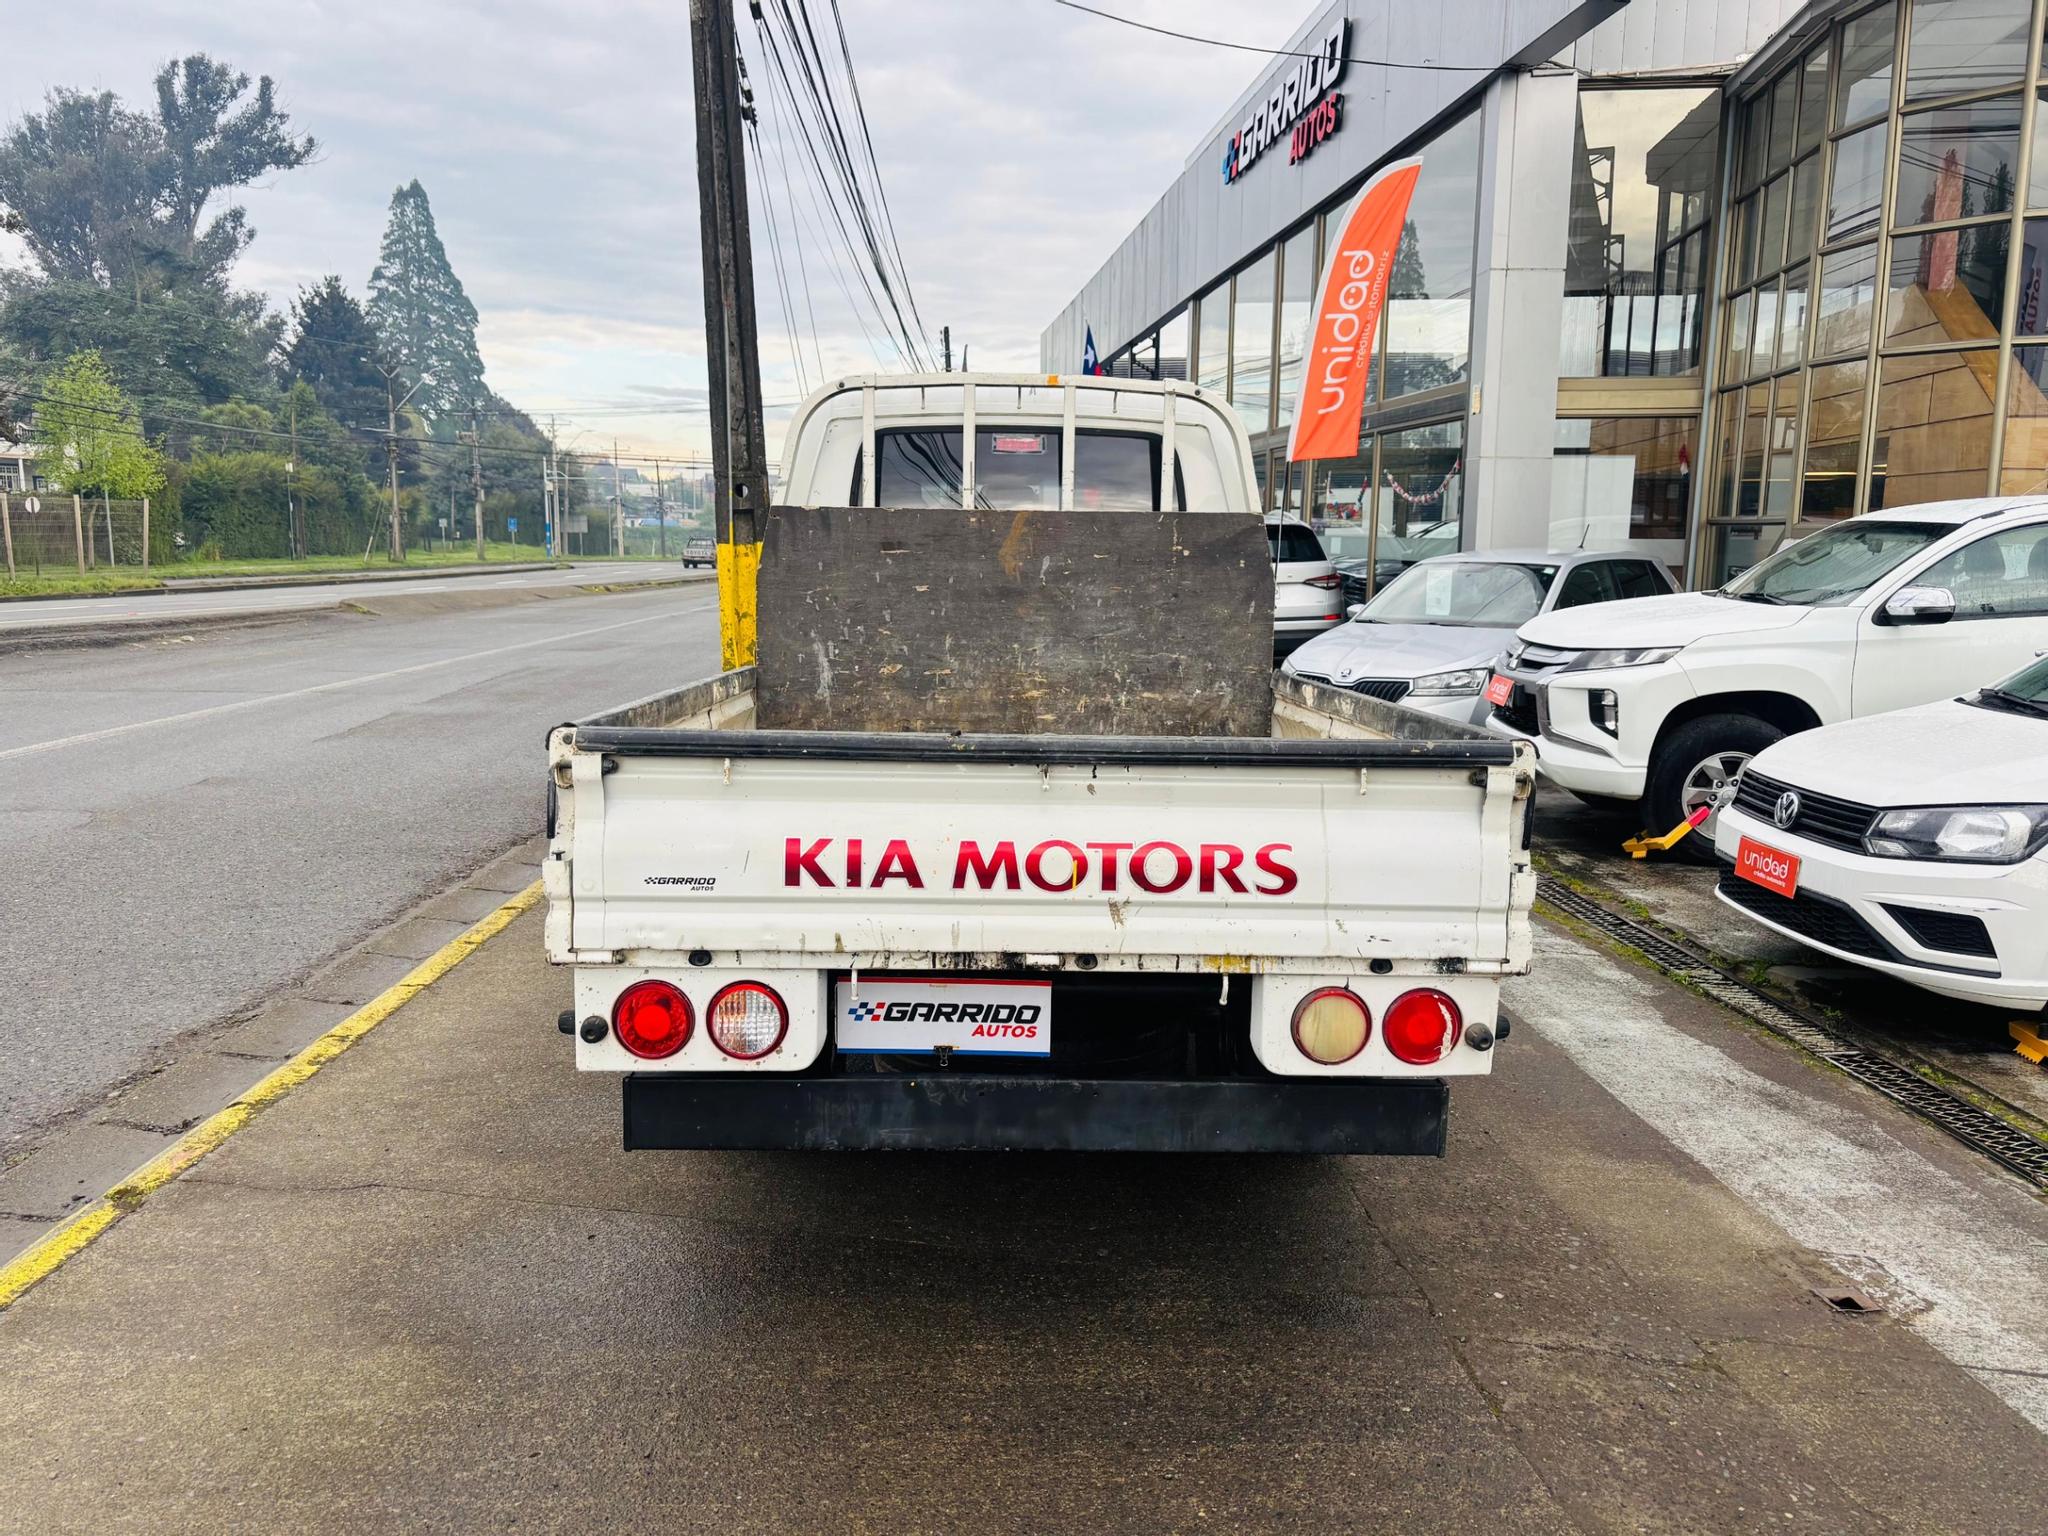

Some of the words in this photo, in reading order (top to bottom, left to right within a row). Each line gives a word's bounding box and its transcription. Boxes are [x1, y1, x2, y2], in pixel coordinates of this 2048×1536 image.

[1237, 17, 1347, 173] GARRIDO
[1289, 92, 1338, 166] AUTOS
[1317, 249, 1375, 415] unidad
[657, 876, 716, 886] GARRIDO
[784, 837, 925, 889] KIA
[952, 839, 1299, 895] MOTORS
[1744, 849, 1789, 879] unidad
[883, 1002, 1042, 1025] GARRIDO
[971, 1024, 1038, 1038] AUTOS
